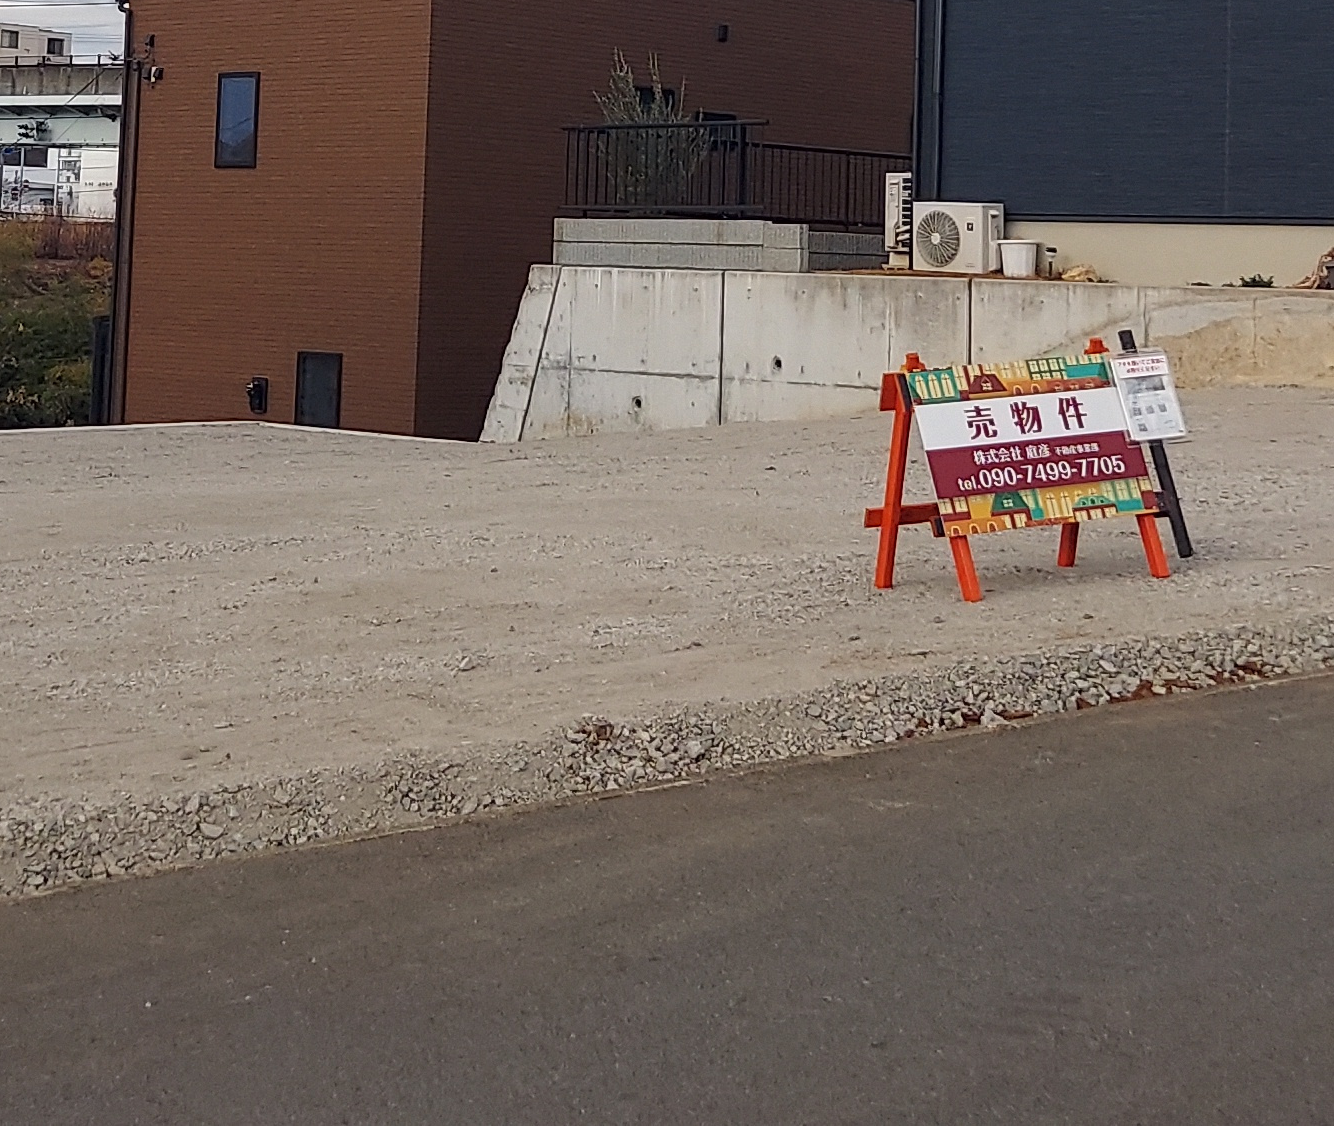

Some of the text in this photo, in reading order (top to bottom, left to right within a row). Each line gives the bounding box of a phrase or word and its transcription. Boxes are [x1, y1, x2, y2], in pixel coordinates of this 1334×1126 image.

[964, 396, 1087, 440] 売物件
[973, 445, 1024, 465] 株式会社
